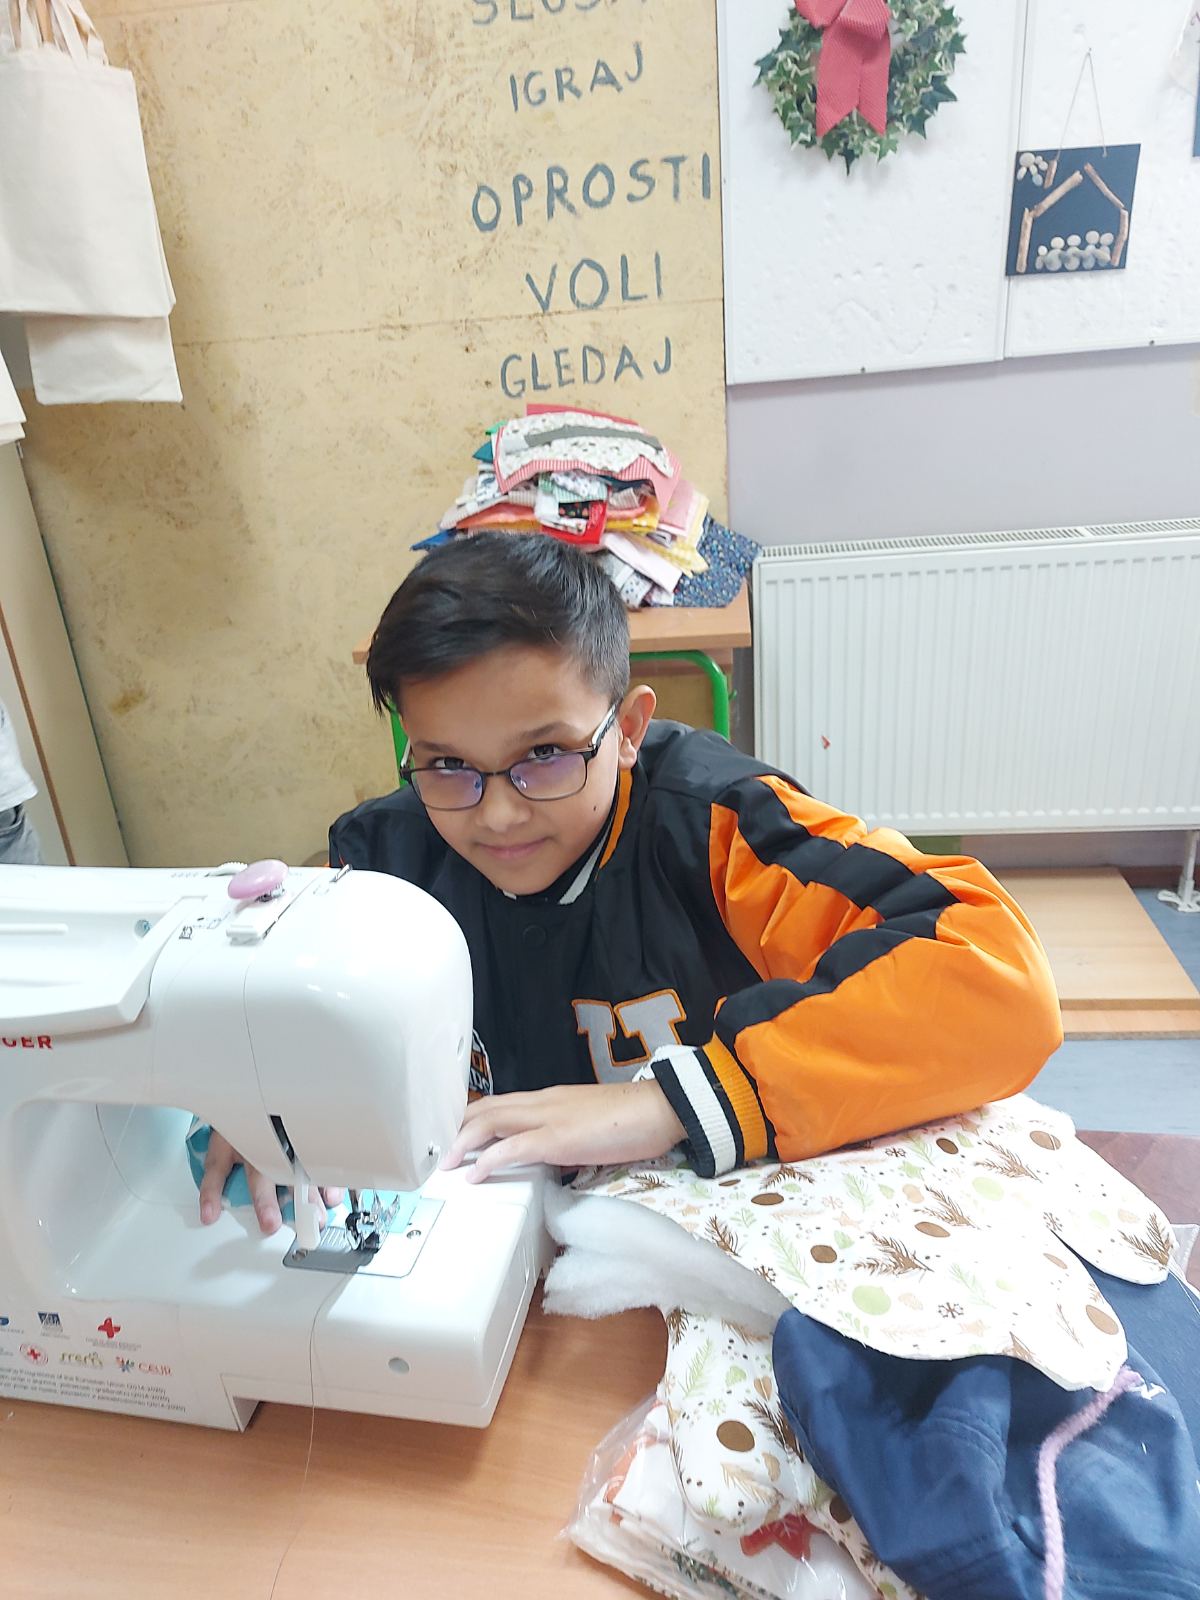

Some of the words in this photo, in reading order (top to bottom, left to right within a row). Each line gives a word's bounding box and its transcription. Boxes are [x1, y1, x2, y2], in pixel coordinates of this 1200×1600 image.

[510, 42, 644, 112] IGRAJ
[472, 152, 711, 232] OPROSTI
[525, 252, 663, 313] VOLI
[500, 337, 672, 398] GLEDAJ
